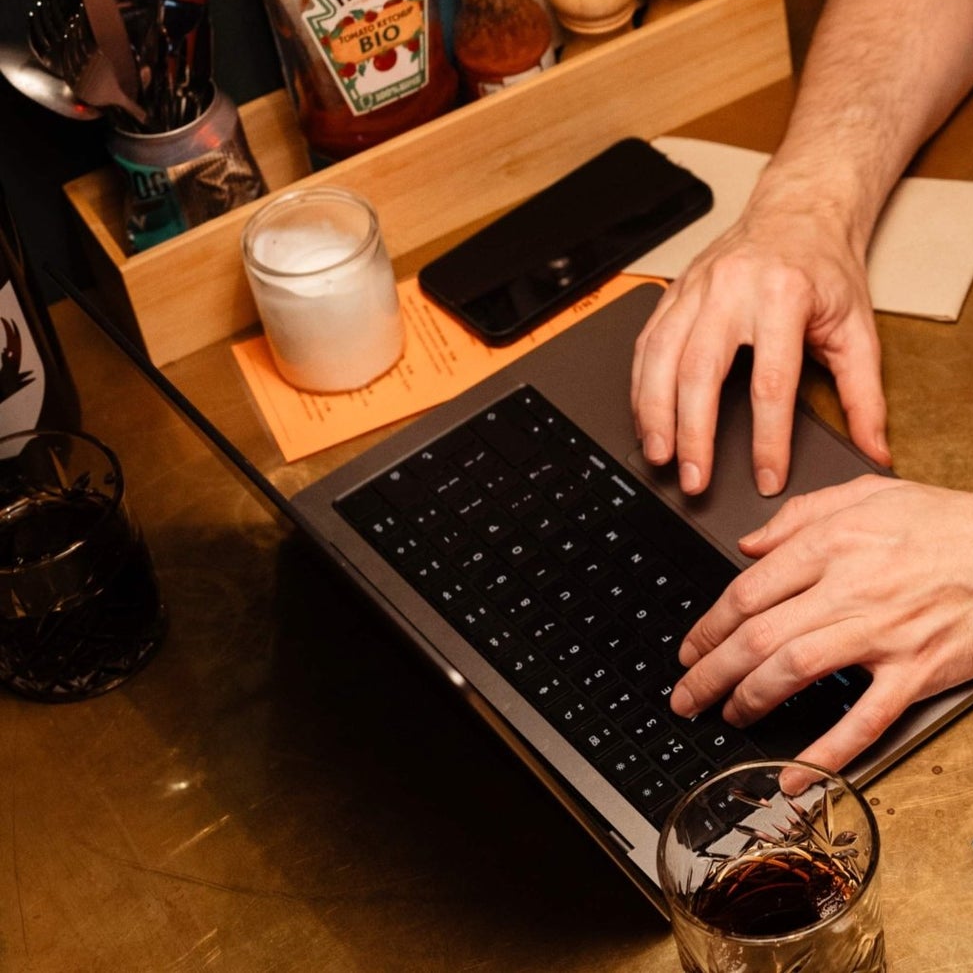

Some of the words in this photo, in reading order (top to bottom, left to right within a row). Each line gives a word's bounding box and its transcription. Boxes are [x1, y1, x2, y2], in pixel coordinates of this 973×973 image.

[339, 22, 376, 44] TOMATO
[359, 25, 400, 54] BIO
[488, 524, 500, 533] P
[605, 530, 619, 542] M
[561, 541, 574, 551] K
[630, 553, 643, 564] N
[496, 574, 508, 584] 9
[655, 576, 668, 586] B
[559, 590, 571, 601] U
[610, 586, 623, 597] H
[519, 597, 531, 608] 8
[680, 600, 692, 610] V
[584, 615, 595, 624] Y
[635, 609, 648, 619] G
[543, 622, 555, 631] 7
[608, 639, 620, 648] T
[661, 635, 673, 643] F
[569, 644, 580, 655] 6
[635, 661, 647, 672] R
[593, 668, 606, 679] 5
[660, 685, 672, 696] E
[619, 693, 630, 702] 4
[646, 718, 657, 728] 3
[714, 734, 726, 747] Q
[672, 743, 684, 754] 2
